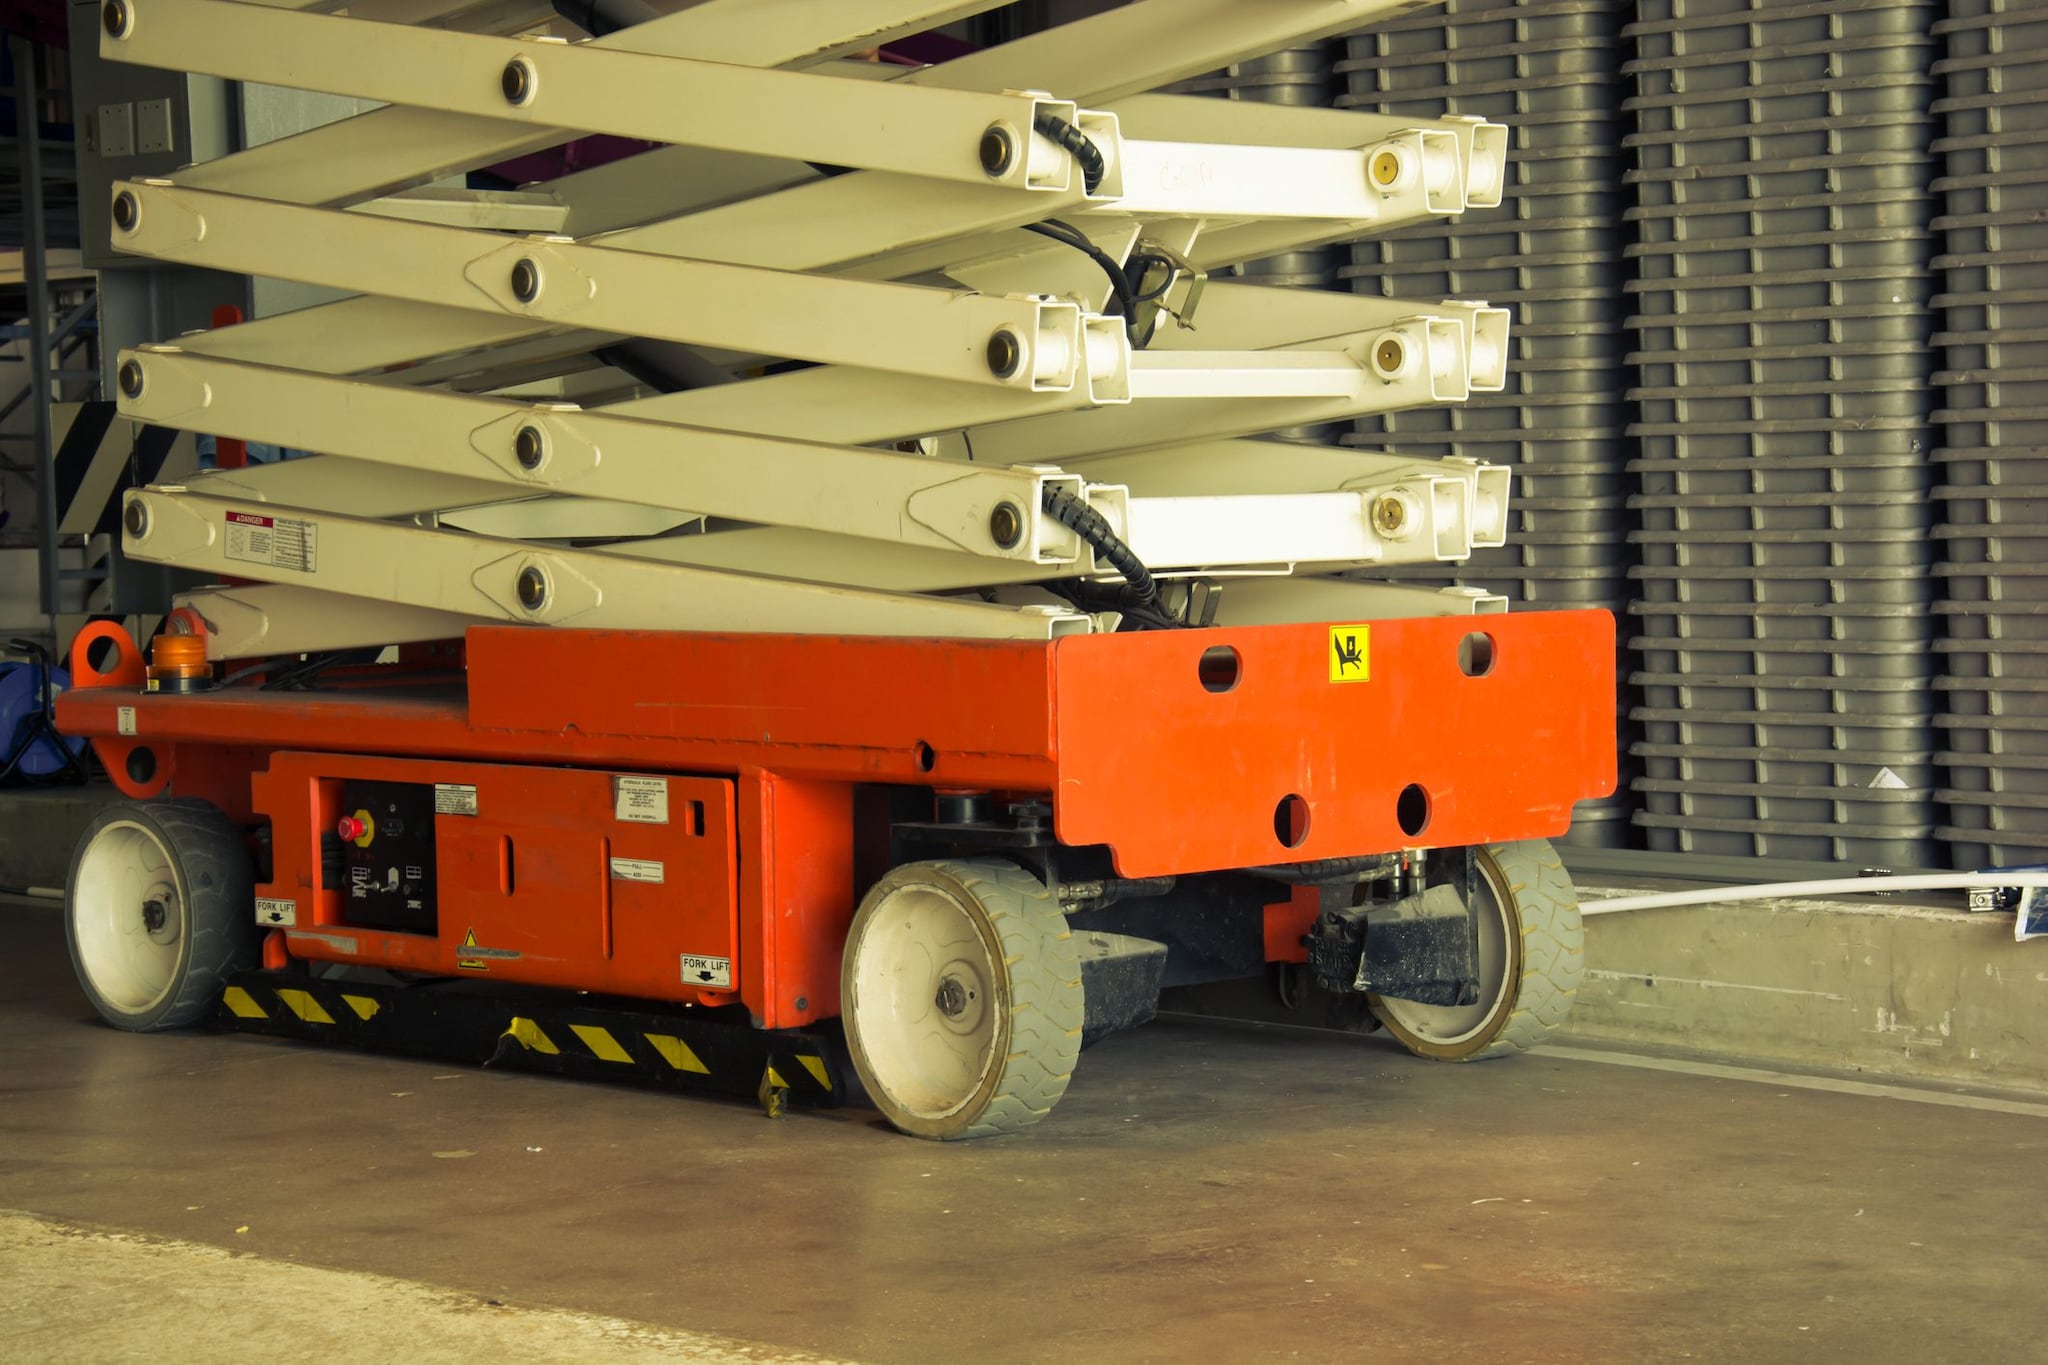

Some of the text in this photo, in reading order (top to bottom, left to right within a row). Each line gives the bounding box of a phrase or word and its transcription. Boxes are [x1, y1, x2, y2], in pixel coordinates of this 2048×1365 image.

[240, 514, 264, 526] DANGER
[257, 901, 295, 912] FORK LIFT
[683, 958, 730, 971] FORK LIFT
